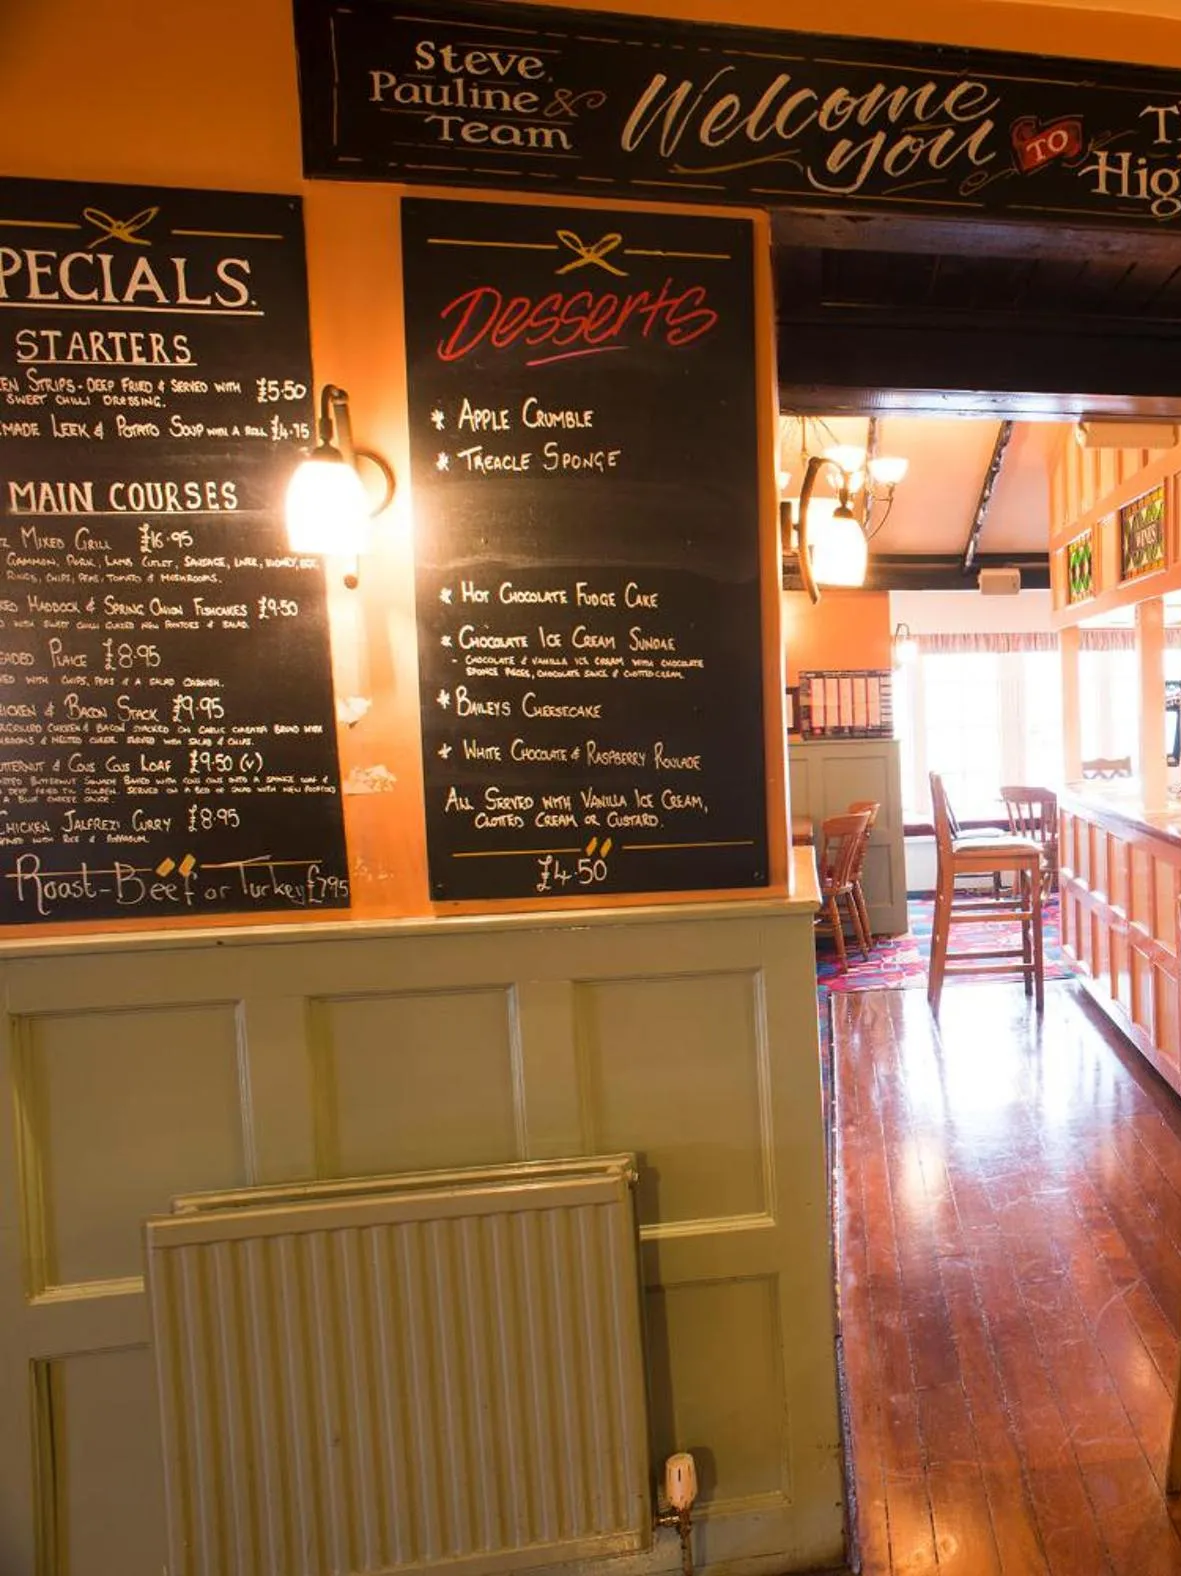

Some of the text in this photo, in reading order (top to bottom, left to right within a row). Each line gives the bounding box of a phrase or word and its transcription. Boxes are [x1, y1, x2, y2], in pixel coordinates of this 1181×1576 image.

[369, 70, 607, 118] Pauline &
[621, 64, 1000, 158] Welcome
[424, 114, 572, 150] Team
[1027, 129, 1069, 162] TO
[808, 119, 997, 194] you
[437, 277, 718, 362] Desserts
[16, 329, 194, 364] STARTERS
[6, 393, 47, 405] SWEET
[86, 377, 114, 393] DEEP
[121, 376, 153, 393] FRIED
[170, 378, 209, 394] SERVED
[213, 381, 242, 394] WITH
[50, 412, 91, 439] LEEK
[116, 413, 160, 438] POTATO
[169, 414, 205, 438] SOUP
[231, 425, 241, 436] A
[458, 397, 594, 432] APPLE CRUMBLE
[457, 441, 621, 475] TREACLE SPONGE
[10, 480, 239, 513] MAIN COURSES
[20, 524, 65, 551] MIXED
[74, 526, 113, 551] GRILL
[104, 594, 145, 616] SPRING
[149, 597, 184, 617] ONION
[461, 581, 659, 608] HOT CHOCOLATE FUDGE CAKE
[48, 636, 88, 669] PLAICE
[458, 624, 676, 651] CHOCOLATE ICE CREAM SUNDAE
[64, 692, 109, 720] BACON
[117, 695, 160, 723] STACK
[455, 684, 603, 719] BAILEYS CHEESECAKE
[140, 753, 172, 774] LOAF
[463, 739, 502, 762] WHITE
[510, 738, 568, 762] CHOCOLATE
[586, 740, 646, 768] RASPBERRY
[654, 741, 702, 771] ROULADE
[444, 786, 475, 813] ALL
[484, 786, 535, 812] SERVED
[542, 793, 572, 811] WITH
[580, 786, 628, 809] VANILLA
[634, 788, 655, 809] ICE
[61, 809, 121, 832] JALFREZI
[131, 809, 173, 832] CURRY
[475, 812, 525, 829] CLOTTED
[534, 812, 579, 829] CREAM
[583, 814, 601, 826] OR
[204, 878, 231, 899] or
[536, 855, 608, 893] £4.50
